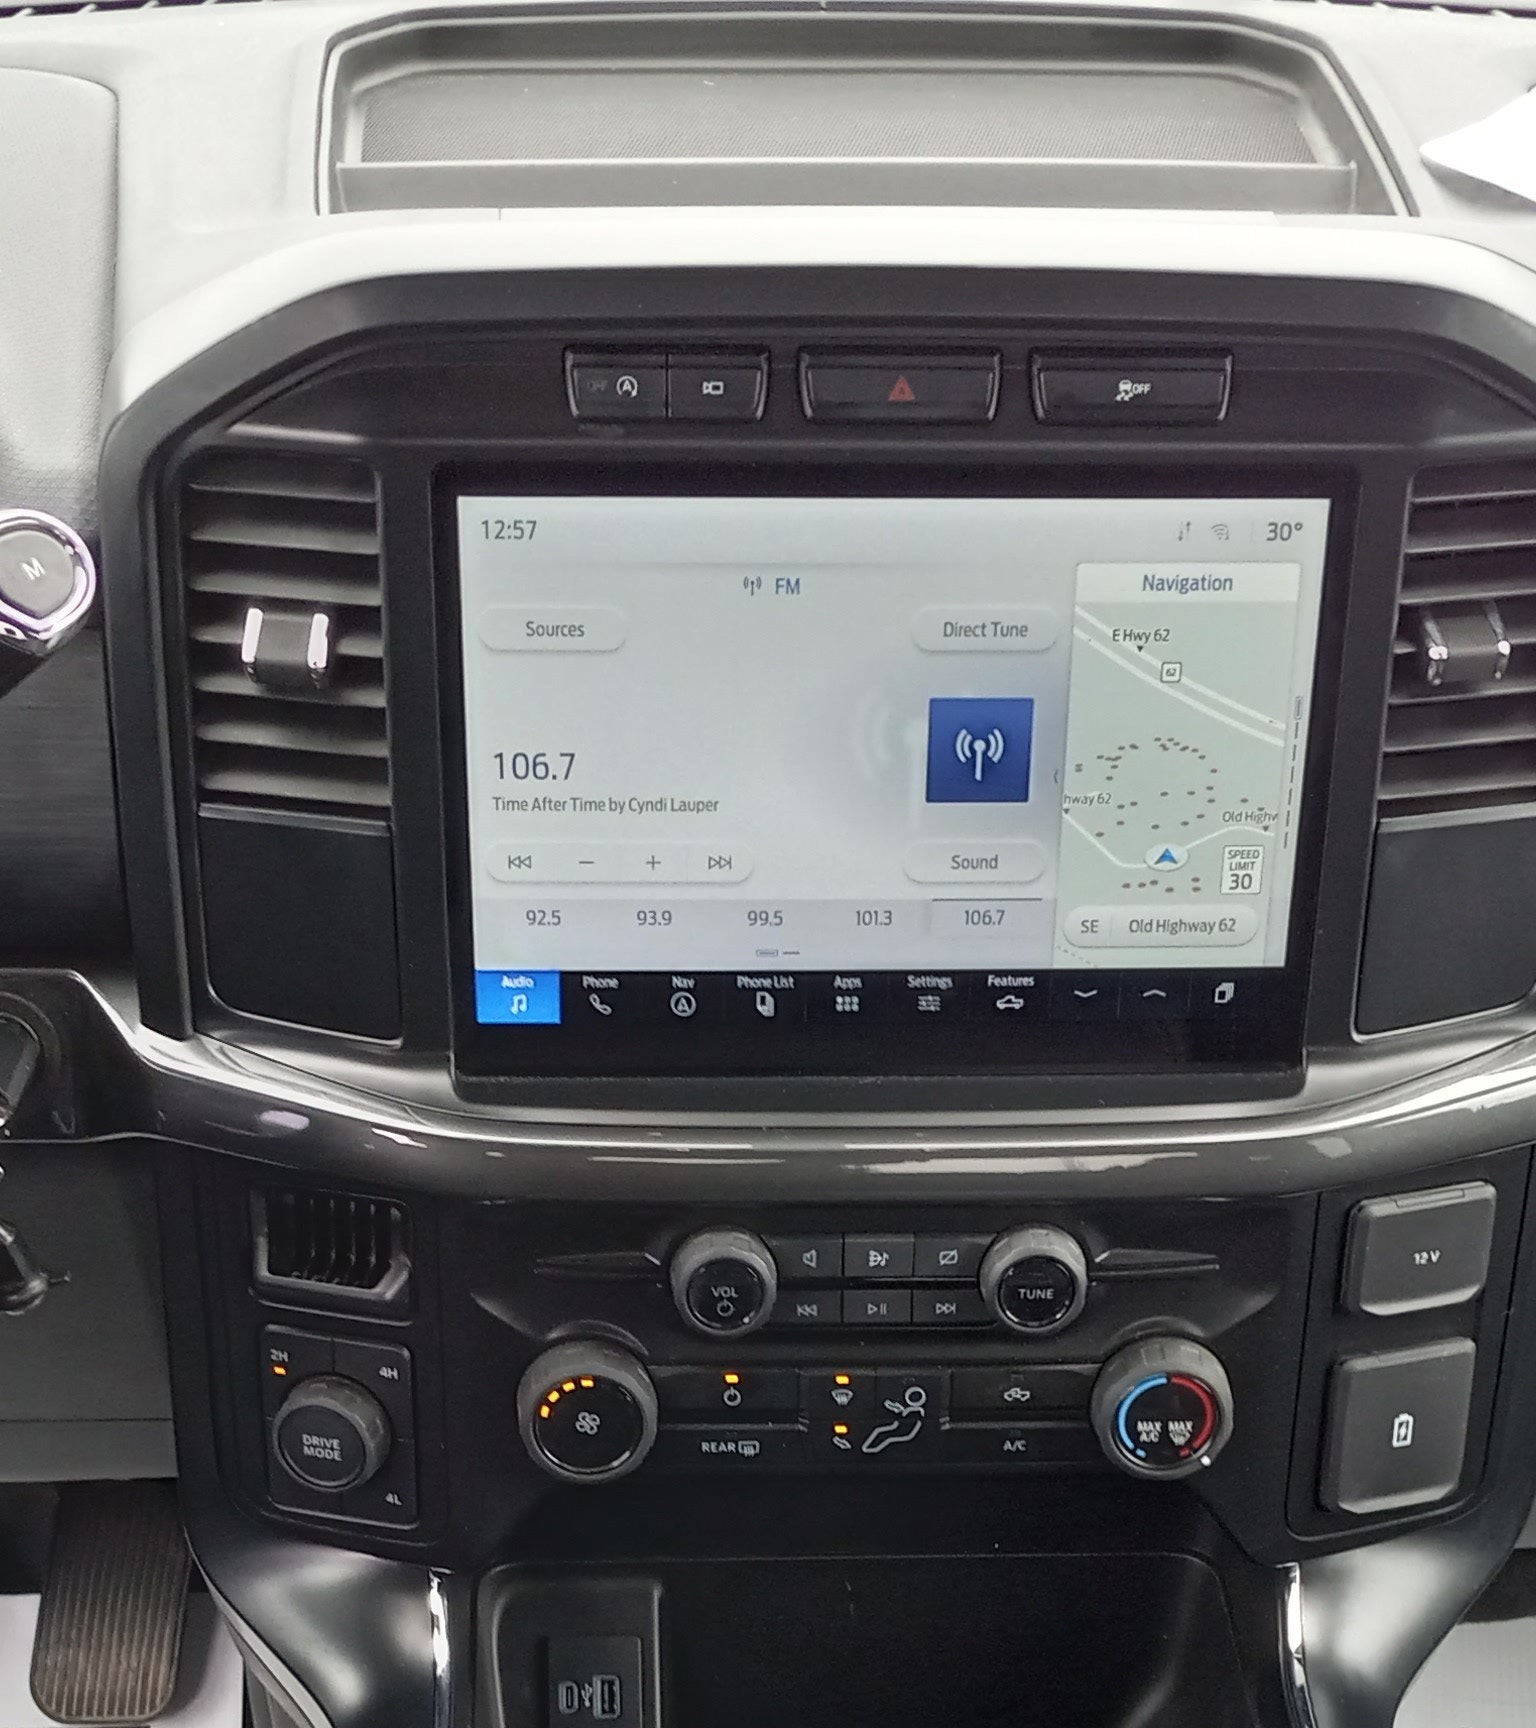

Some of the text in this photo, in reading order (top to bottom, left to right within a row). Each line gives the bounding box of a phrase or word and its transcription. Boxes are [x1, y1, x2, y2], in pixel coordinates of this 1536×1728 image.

[1132, 383, 1151, 394] OFF
[481, 520, 537, 540] 12:57
[1266, 522, 1303, 541] 30°
[21, 557, 47, 580] M
[775, 578, 801, 595] FM
[1142, 574, 1233, 594] Navigation
[525, 620, 585, 637] Sources
[942, 621, 1029, 638] Direct Tune
[1112, 629, 1170, 645] E Hwy 62
[493, 752, 576, 780] 106.7
[492, 796, 719, 815] Time After Time by Cyndi Lauper
[1097, 793, 1112, 806] 62
[1222, 811, 1241, 823] Old
[1227, 849, 1260, 860] SPEED
[951, 855, 998, 870] Sound
[1229, 861, 1256, 871] LIMIT
[1229, 873, 1253, 890] 30
[526, 910, 561, 926] 92.5
[637, 910, 672, 926] 93.9
[747, 910, 783, 927] 99.5
[856, 910, 893, 926] 101.3
[964, 910, 1005, 926] 106.7
[1081, 919, 1099, 934] SE
[1129, 918, 1236, 938] Old Highway 62
[501, 975, 534, 988] Audio
[582, 975, 619, 988] Phone
[672, 975, 695, 988] Nav
[736, 975, 794, 989] Phone List
[834, 975, 862, 990] Apps
[907, 975, 953, 990] Settings
[987, 975, 1034, 988] Features
[712, 1287, 738, 1298] VOL
[1018, 1288, 1055, 1300] TUNE
[270, 1349, 289, 1363] 2H
[379, 1366, 399, 1380] 4H
[1137, 1420, 1162, 1432] MAX
[1168, 1420, 1193, 1432] MAX
[302, 1434, 341, 1449] DRIVE
[701, 1442, 736, 1453] REAR
[1003, 1440, 1026, 1452] A/C
[303, 1447, 343, 1461] MODE
[385, 1493, 402, 1506] 4L
